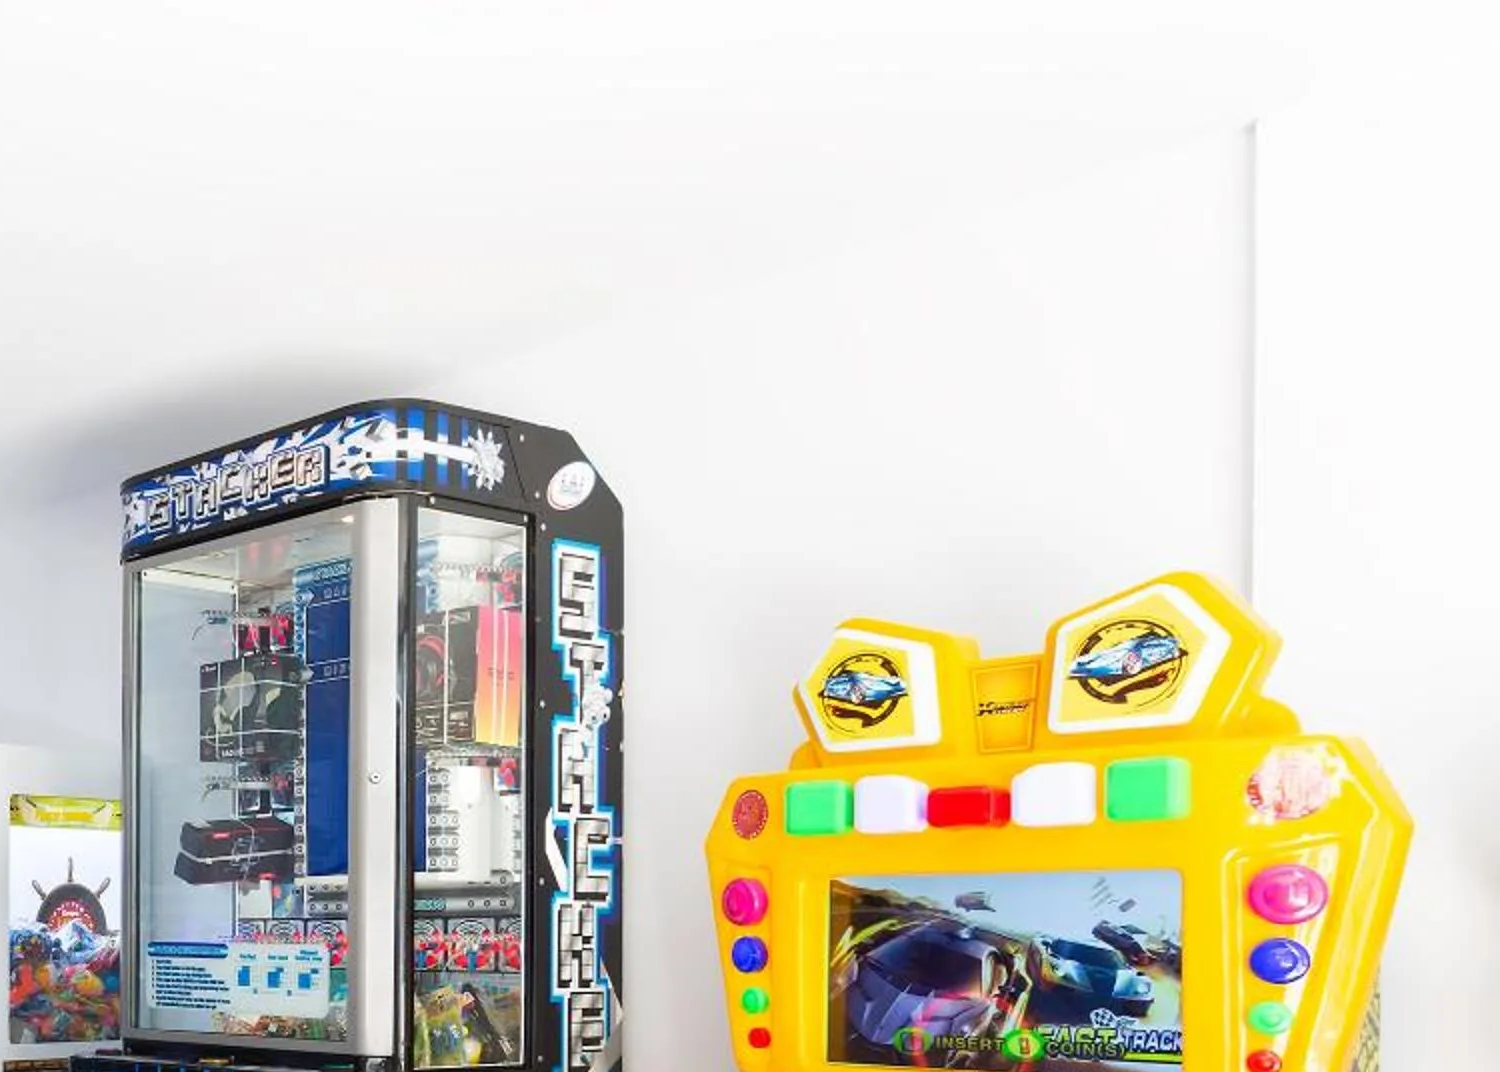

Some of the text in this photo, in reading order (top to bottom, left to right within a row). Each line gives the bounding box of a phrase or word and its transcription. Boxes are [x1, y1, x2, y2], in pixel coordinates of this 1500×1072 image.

[147, 447, 329, 531] STACKER
[934, 1036, 1004, 1052] INSERT
[1046, 1040, 1125, 1058] COIN(S)
